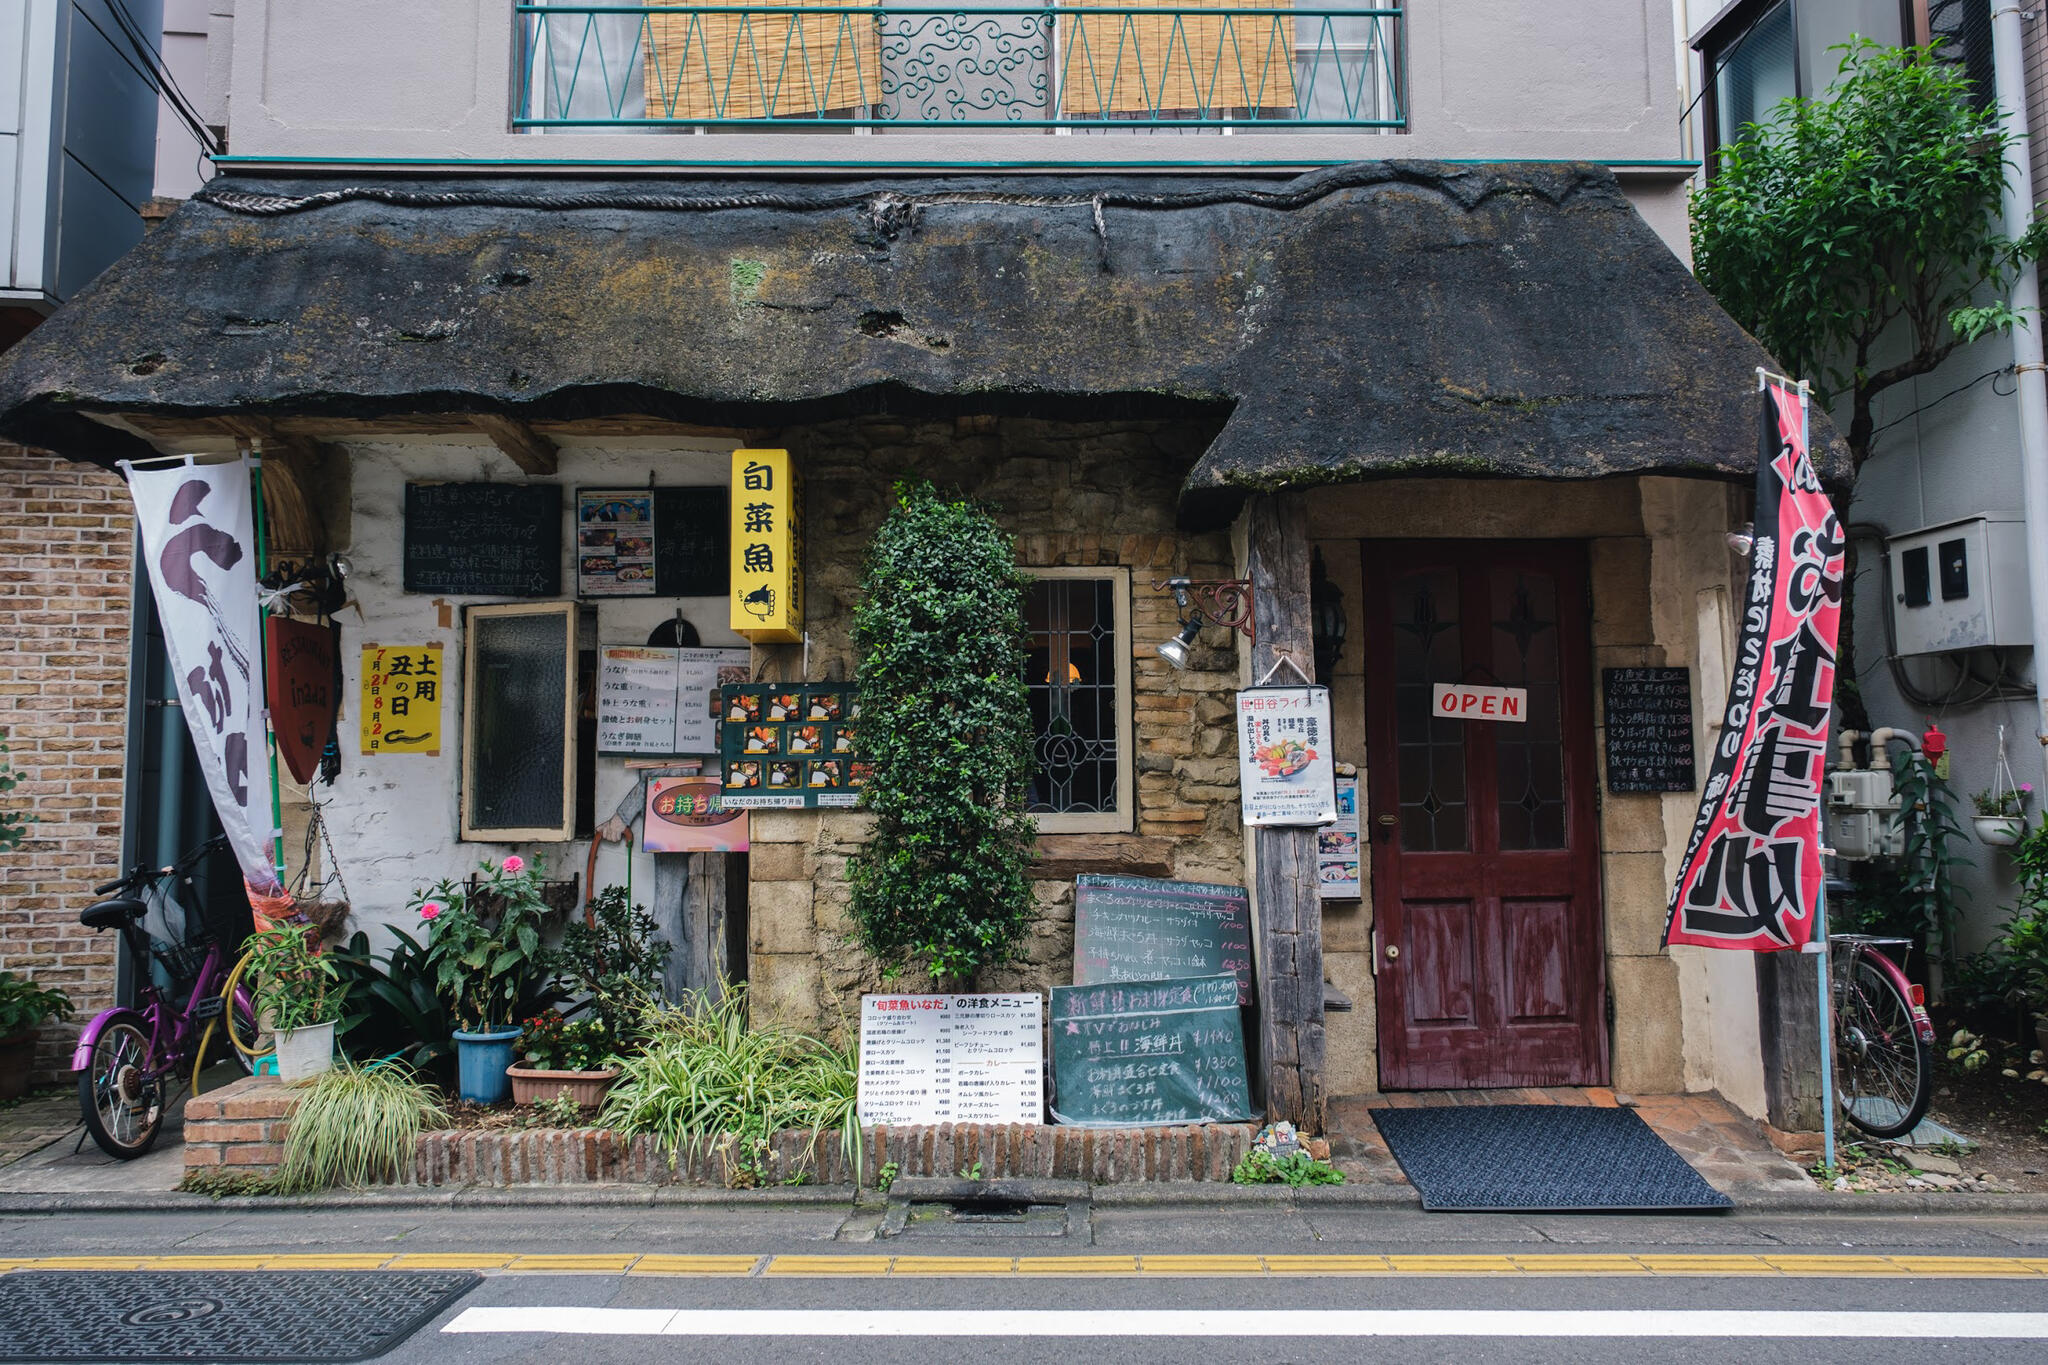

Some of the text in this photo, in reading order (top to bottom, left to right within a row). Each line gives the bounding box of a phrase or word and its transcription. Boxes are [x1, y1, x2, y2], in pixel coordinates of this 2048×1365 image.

[743, 460, 774, 573] 旬菜魚
[388, 654, 413, 717] 丑の日
[414, 653, 438, 702] 土用
[1240, 698, 1312, 710] 世田谷ライフ
[1441, 692, 1519, 717] OPEN
[1306, 716, 1319, 746] 豪徳寺
[724, 798, 802, 806] いなだのお持ち帰り弁当
[871, 998, 1034, 1010] 「旬菜魚いなだ」 の洋食メニュー
